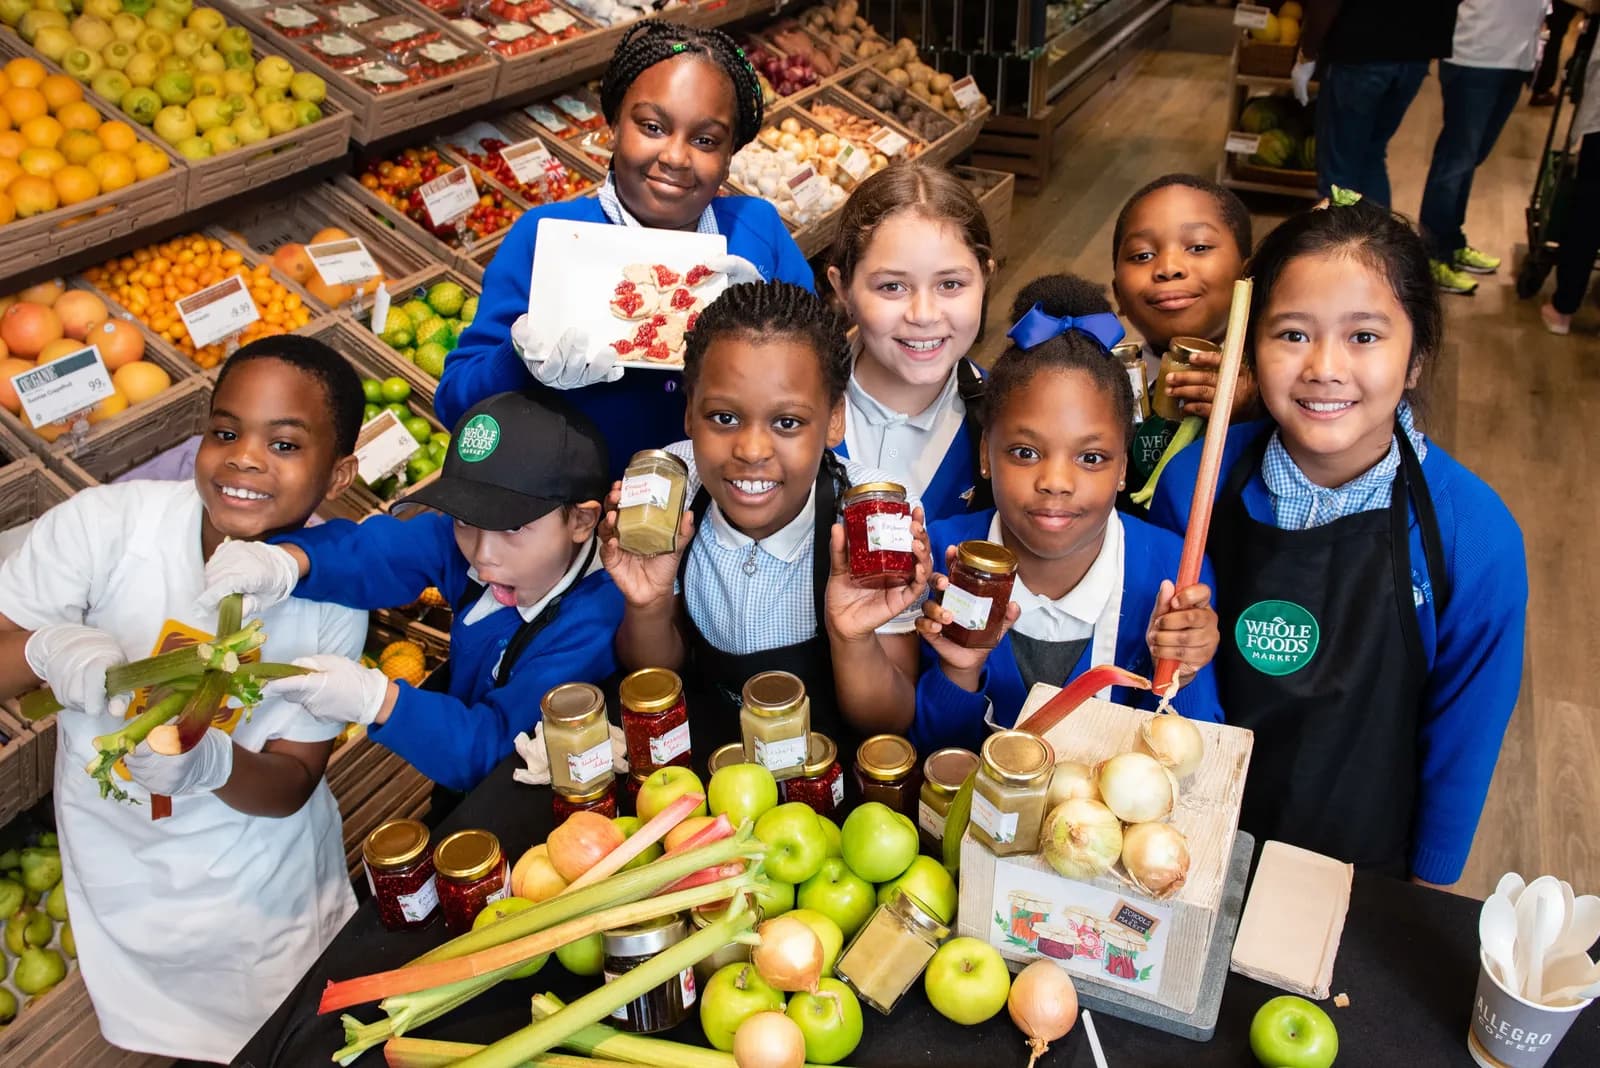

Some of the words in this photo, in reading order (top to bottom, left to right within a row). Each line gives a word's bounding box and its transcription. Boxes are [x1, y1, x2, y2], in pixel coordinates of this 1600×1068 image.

[464, 425, 497, 441] WHOLE
[461, 438, 493, 450] FOODS
[1244, 617, 1312, 639] WHOLE
[1246, 634, 1309, 653] FOODS
[1252, 651, 1298, 662] MARKET
[1117, 915, 1146, 933] MARKET
[1122, 908, 1151, 927] SCHOOLS
[1477, 995, 1552, 1045] ALLEGRO
[1478, 1015, 1541, 1053] COFFEE
